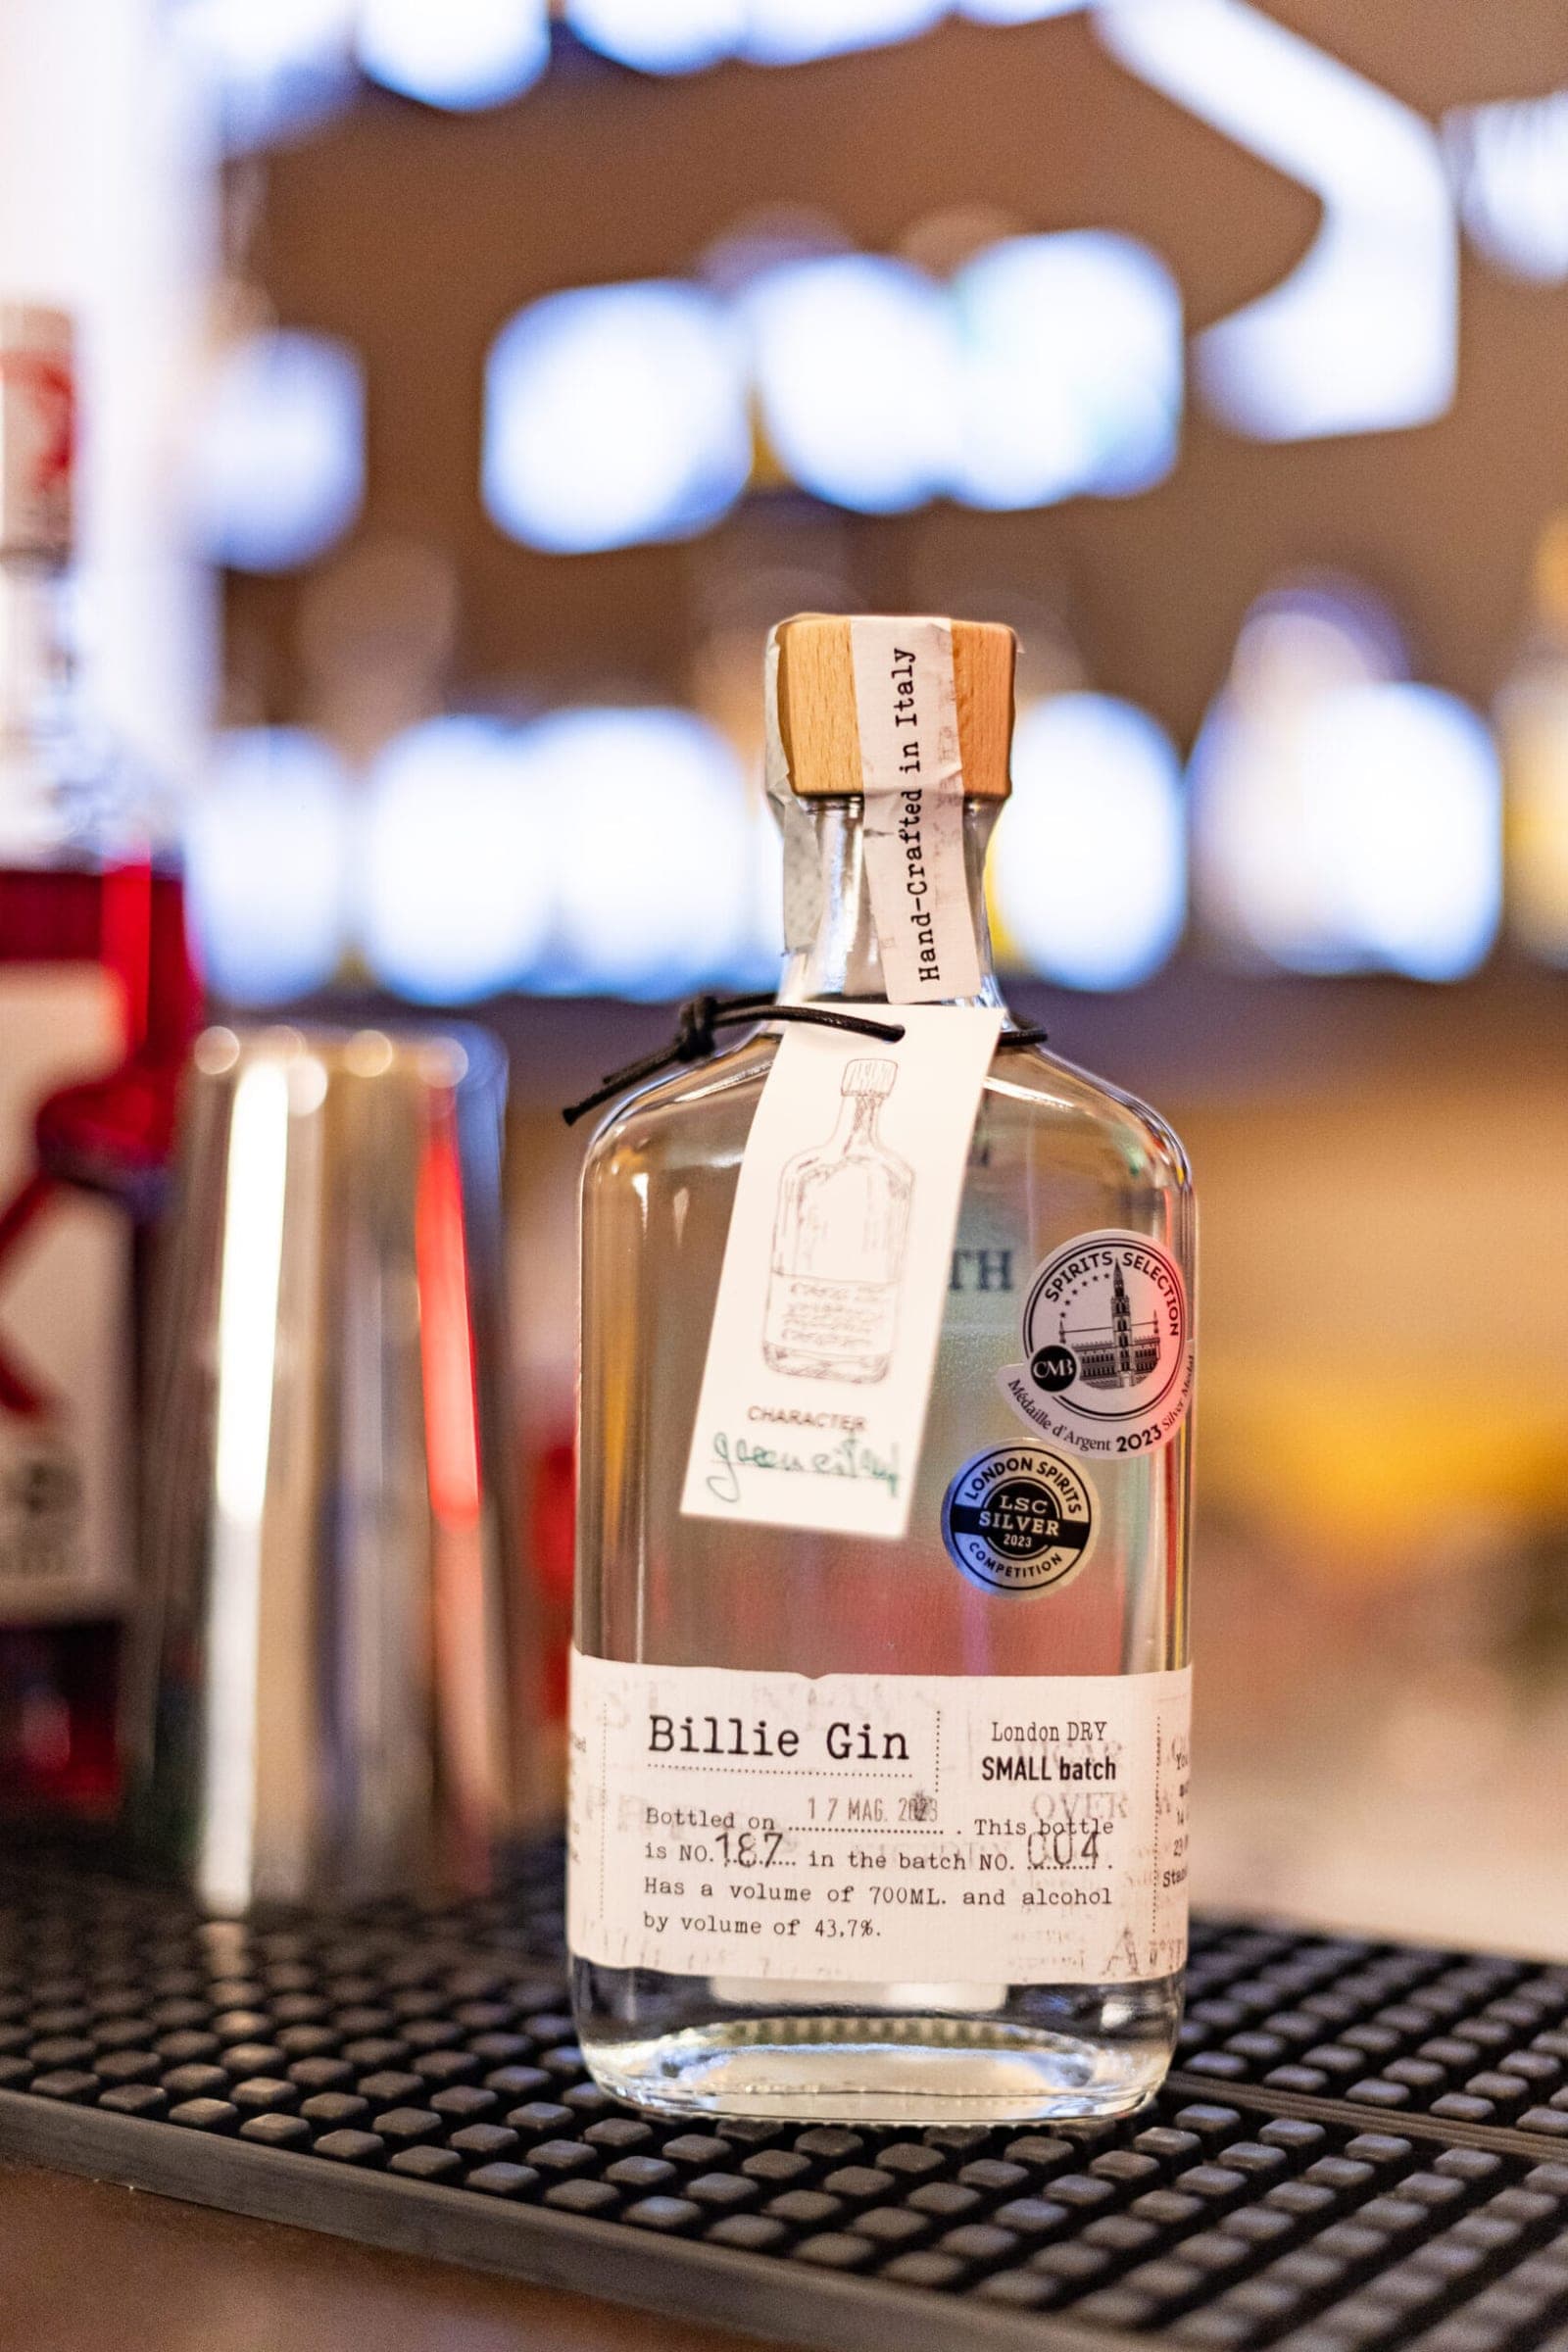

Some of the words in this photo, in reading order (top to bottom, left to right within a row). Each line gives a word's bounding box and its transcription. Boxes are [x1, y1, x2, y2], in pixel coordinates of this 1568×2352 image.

[892, 648, 918, 727] Italy
[900, 742, 921, 772] in
[900, 788, 940, 982] Hand-Crafted
[1045, 1251, 1113, 1302] SPIRITS
[1122, 1252, 1179, 1336] SELECTION
[748, 1405, 866, 1431] CHARACTER
[1007, 1379, 1054, 1430] Médaille
[1116, 1424, 1162, 1452] 2023
[964, 1456, 1033, 1500] LONDON
[1037, 1461, 1082, 1514] SPIRITS
[1000, 1494, 1048, 1514] LSC
[978, 1510, 1059, 1537] SILVER
[1003, 1534, 1032, 1547] 2023
[969, 1542, 1062, 1578] COMPETITION
[648, 1715, 800, 1757] Billie
[826, 1721, 909, 1760] Gin
[991, 1721, 1059, 1741] London
[1066, 1721, 1107, 1741] DRY
[982, 1755, 1052, 1781] SMALL
[1059, 1755, 1116, 1781] batch
[646, 1807, 735, 1830] Bottled
[748, 1814, 775, 1830] on
[974, 1818, 1027, 1836] This
[1039, 1818, 1113, 1837] bottle
[645, 1841, 667, 1859] is
[808, 1850, 834, 1867] in
[848, 1850, 887, 1869] the
[900, 1851, 966, 1870] batch
[644, 1877, 685, 1895] Has
[701, 1884, 713, 1897] a
[730, 1883, 811, 1902] volume
[827, 1886, 855, 1902] of
[869, 1886, 947, 1905] 700ML.
[962, 1888, 1005, 1906] and
[1022, 1887, 1113, 1906] alcohol
[643, 1911, 668, 1934] by
[680, 1915, 761, 1935] volume
[773, 1918, 801, 1936] of
